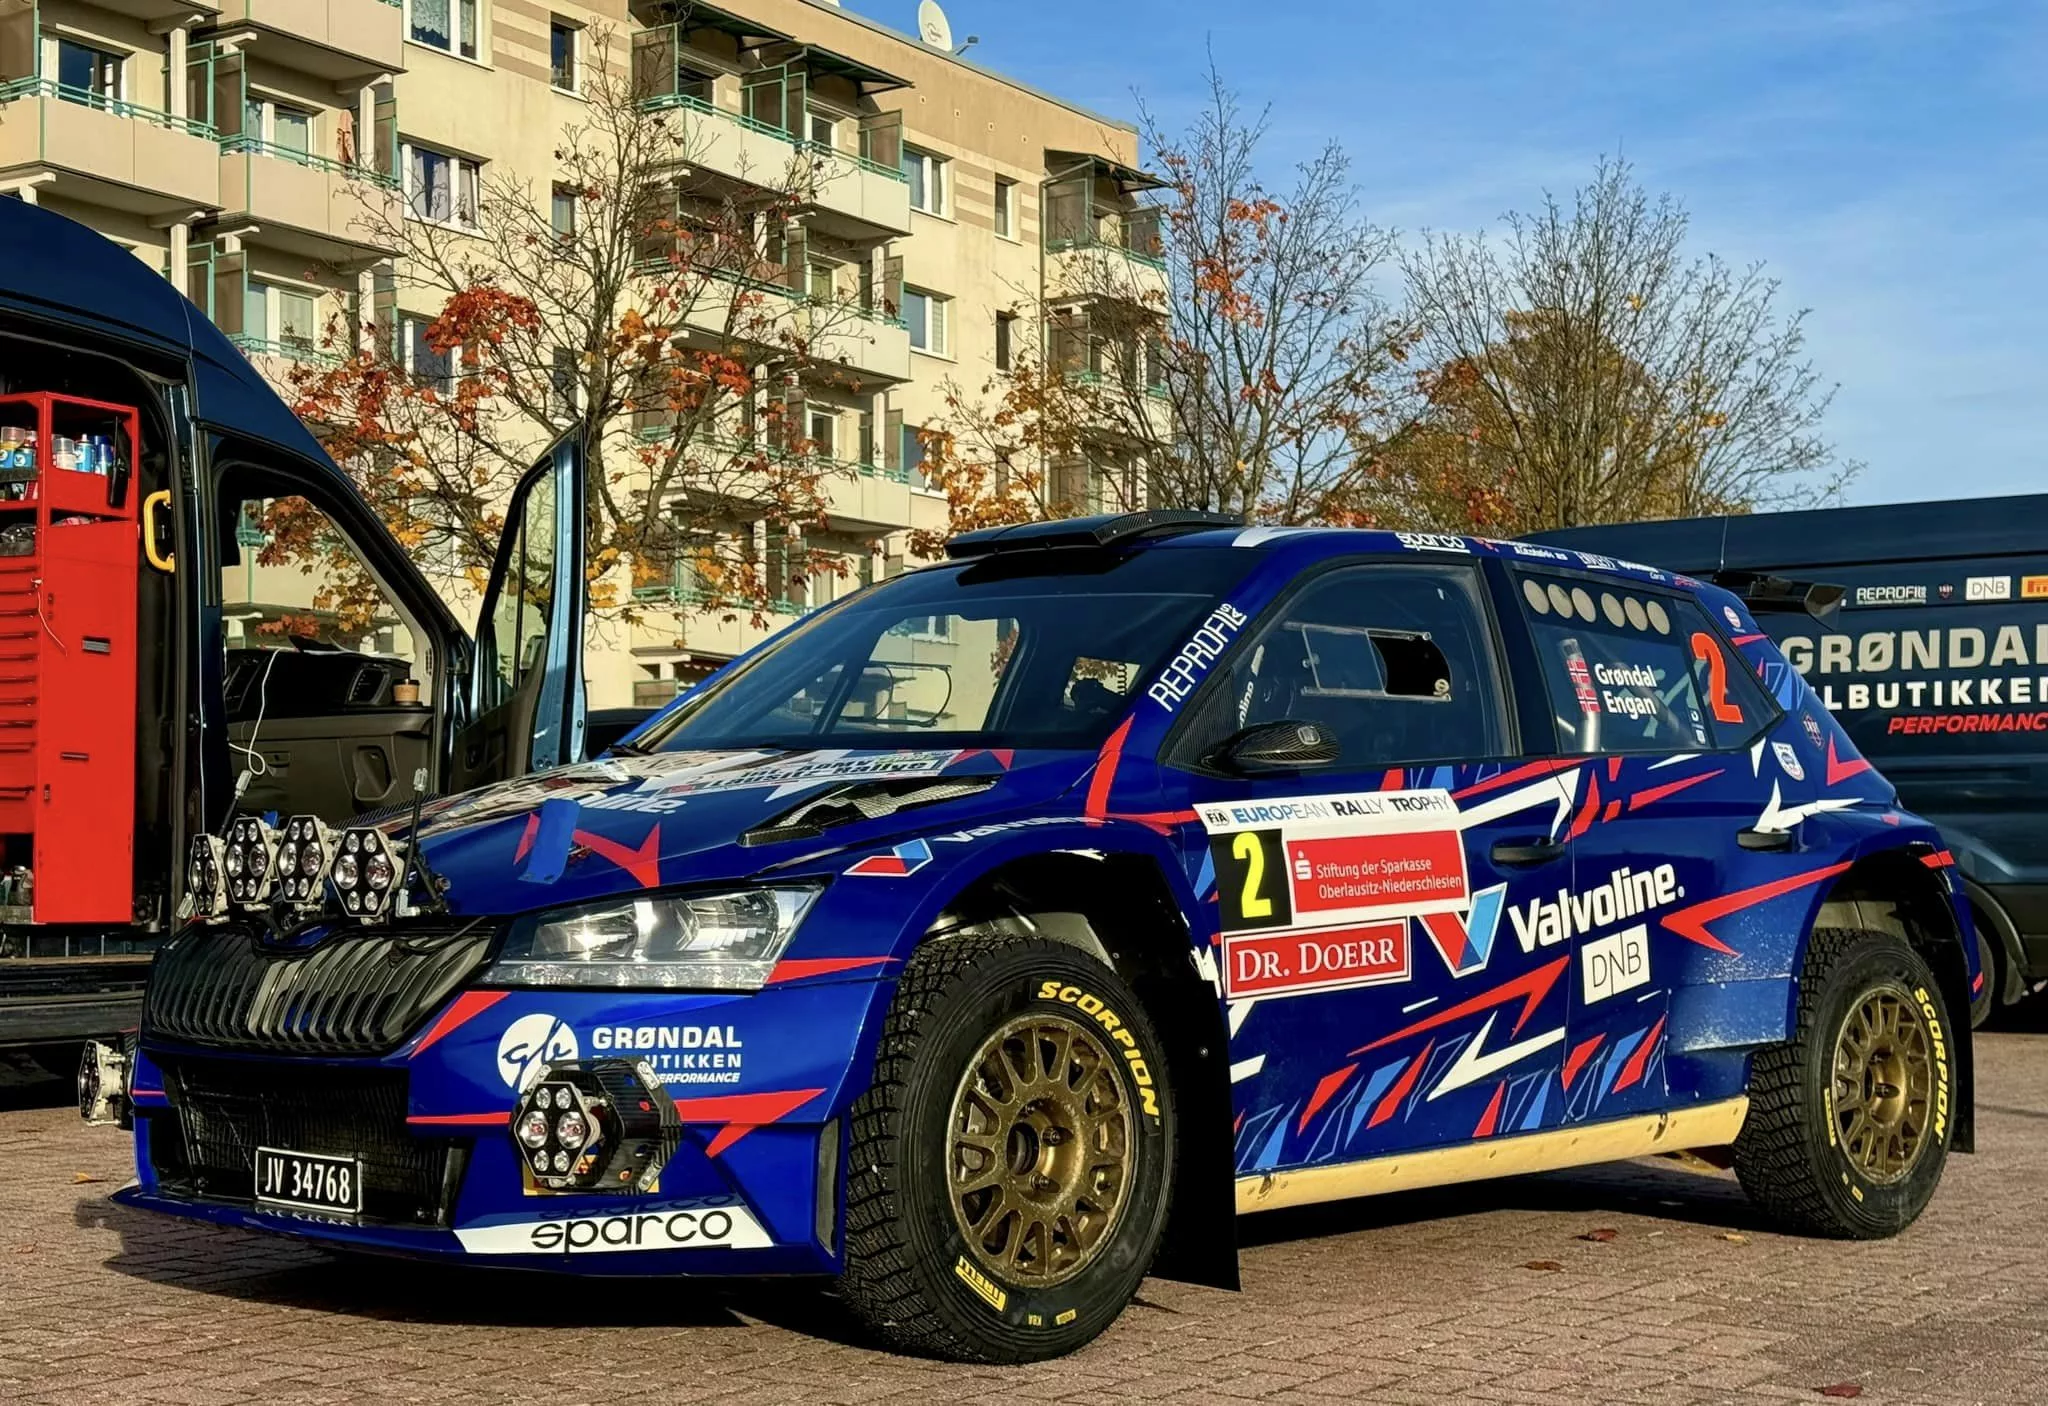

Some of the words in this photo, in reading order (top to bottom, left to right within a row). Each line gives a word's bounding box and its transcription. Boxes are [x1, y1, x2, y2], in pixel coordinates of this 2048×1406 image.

[1971, 577, 2007, 599] DNB
[1148, 609, 1247, 712] REPROFIL
[1594, 663, 1658, 688] Grøndal
[1690, 632, 1744, 723] 2
[1603, 690, 1657, 720] Engan
[1206, 810, 1227, 825] FIA
[1230, 801, 1330, 825] EUROPEAN
[1331, 798, 1387, 817] RALLY
[1388, 793, 1453, 813] TROPHY
[1232, 832, 1273, 919] 2
[1316, 863, 1360, 880] Stiftung
[1361, 861, 1380, 876] der
[1380, 858, 1432, 875] Sparkasse
[1318, 875, 1462, 899] Oberlausitz-Niederschlesien
[1591, 936, 1642, 994] DNB
[592, 1026, 742, 1049] GRØNDAL
[1038, 981, 1160, 1118] SCORPION
[656, 1072, 741, 1085] ERFORMANCE
[1914, 987, 1950, 1139] SCORPION
[264, 1157, 285, 1194] JV
[291, 1160, 351, 1204] 34768
[531, 1210, 733, 1253] sparco
[954, 1255, 1008, 1312] PIRELLI
